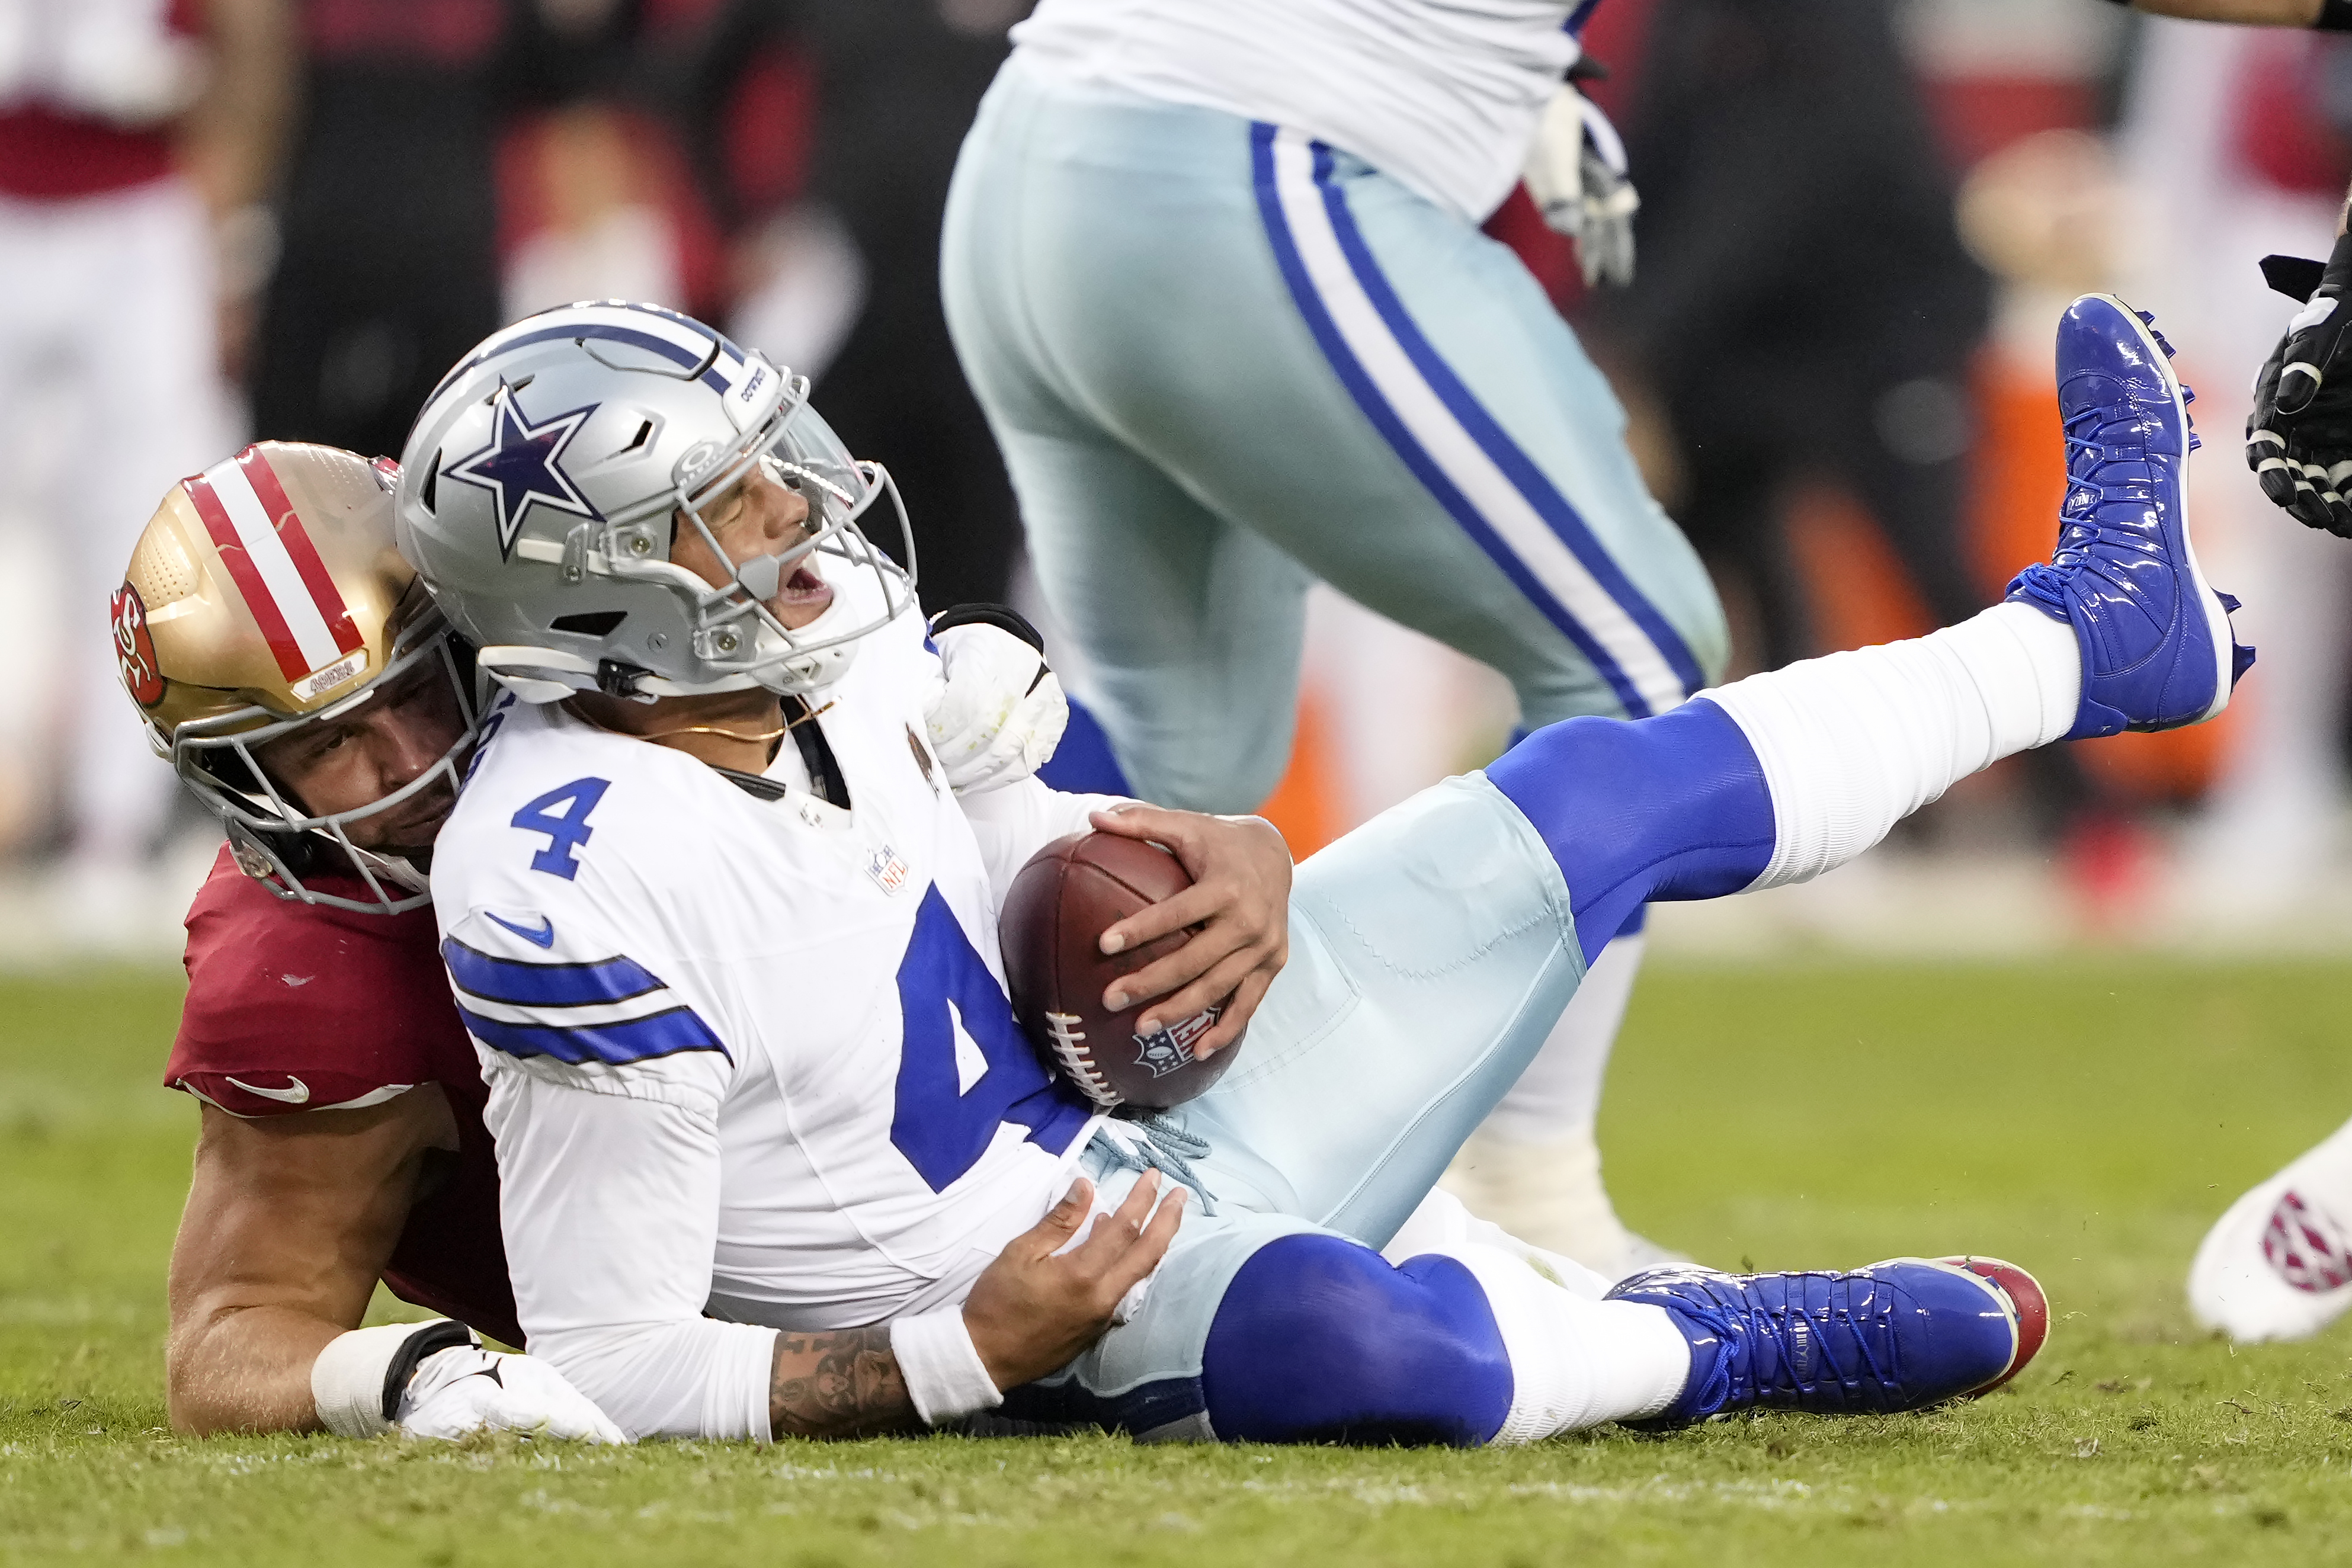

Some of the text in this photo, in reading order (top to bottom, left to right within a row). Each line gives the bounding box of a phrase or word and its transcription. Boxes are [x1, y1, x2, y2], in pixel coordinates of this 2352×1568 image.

[511, 777, 611, 881] 4
[883, 861, 906, 889] NFL
[890, 878, 1094, 1195] 4
